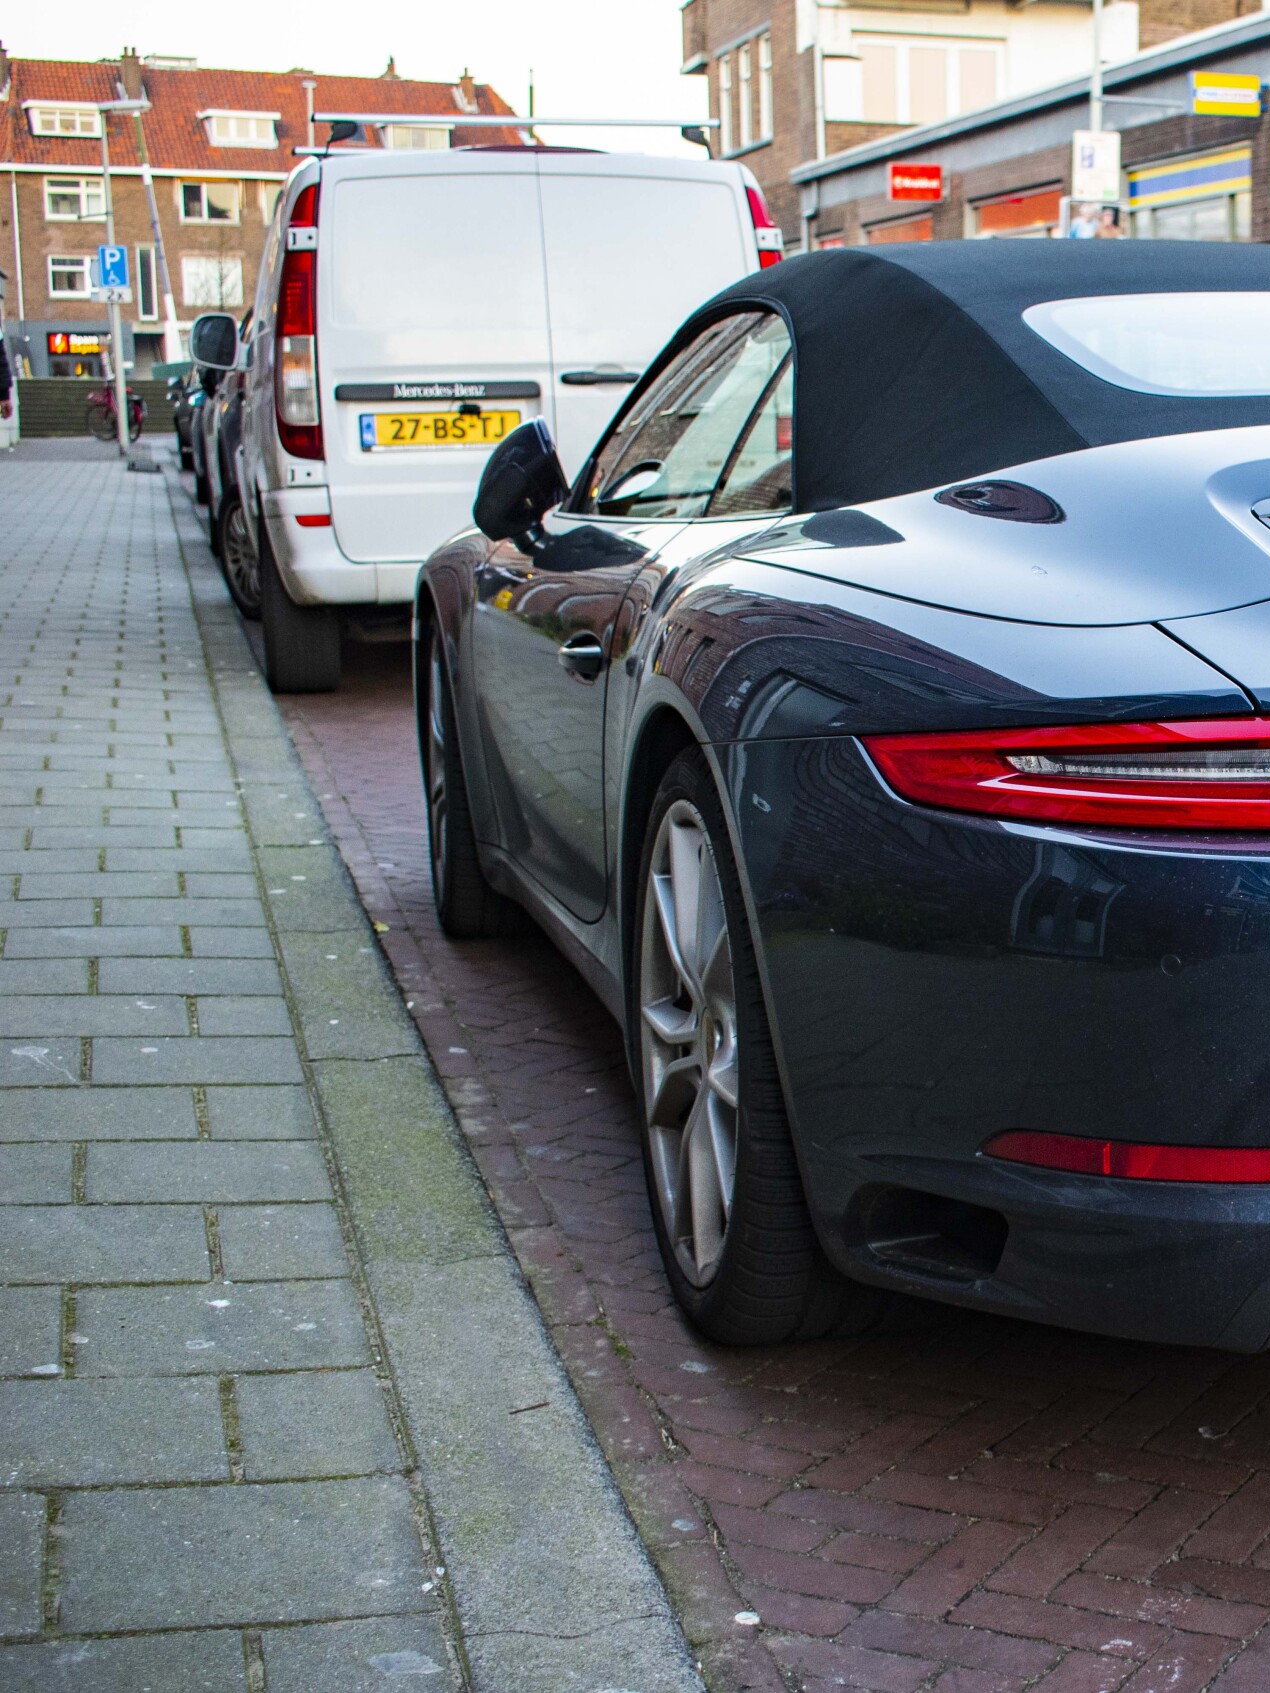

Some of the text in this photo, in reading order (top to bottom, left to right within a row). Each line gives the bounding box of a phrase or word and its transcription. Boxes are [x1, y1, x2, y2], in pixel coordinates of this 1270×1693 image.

[104, 249, 120, 270] P
[393, 383, 486, 399] Mercedes-Benz
[390, 415, 506, 441] 27-BS-TJ
